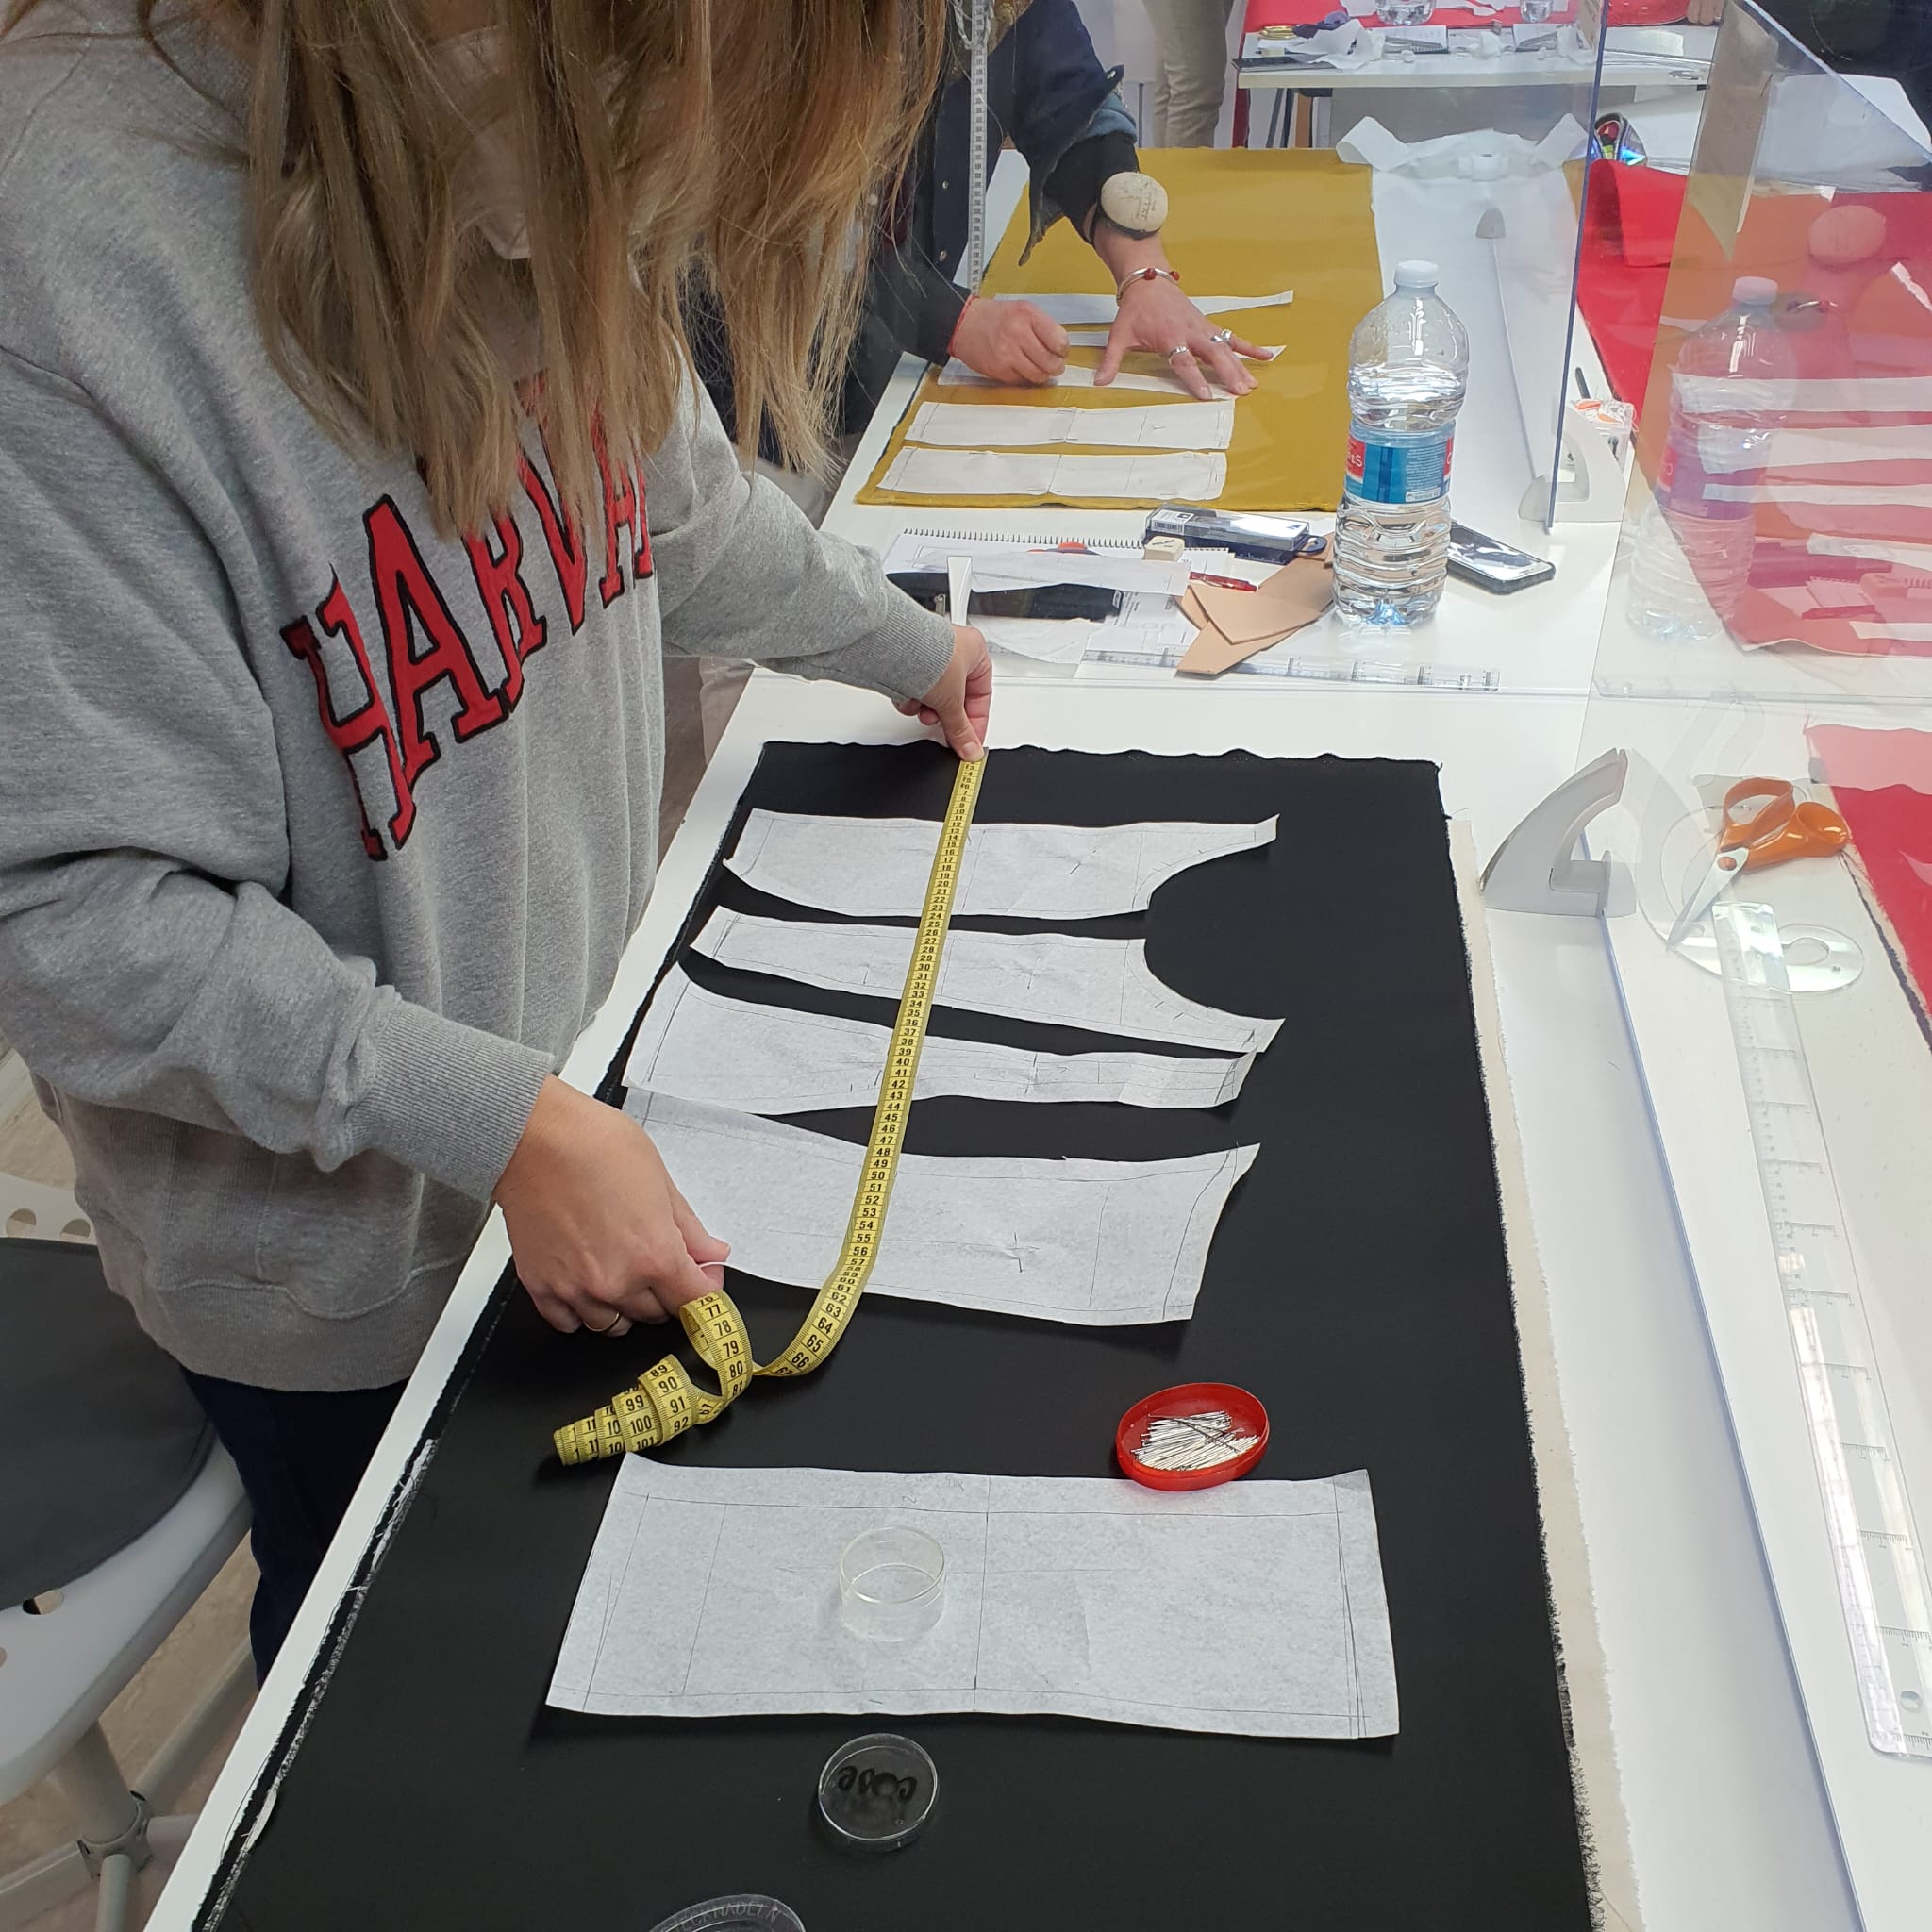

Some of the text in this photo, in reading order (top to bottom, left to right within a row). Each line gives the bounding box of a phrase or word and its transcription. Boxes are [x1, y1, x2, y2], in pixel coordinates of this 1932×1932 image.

[891, 1079, 906, 1089] 42
[890, 1091, 903, 1100] 43
[885, 1113, 898, 1122] 45
[881, 1124, 896, 1133] 46
[879, 1136, 893, 1144] 47
[876, 1147, 891, 1156] 48
[874, 1159, 889, 1168] 49
[871, 1171, 885, 1180] 50
[869, 1183, 882, 1191] 51
[865, 1195, 880, 1205] 52
[862, 1208, 876, 1217] 53
[858, 1221, 874, 1230] 54
[856, 1233, 871, 1243] 55
[853, 1246, 868, 1256] 56
[838, 1284, 851, 1292] 61
[832, 1292, 847, 1304] 62
[705, 1304, 721, 1317] 77
[825, 1303, 841, 1318] 63
[713, 1320, 732, 1337] 78
[818, 1317, 834, 1334] 64
[723, 1340, 739, 1357] 79
[807, 1334, 823, 1353] 65
[792, 1352, 809, 1368] 66
[650, 1365, 668, 1377] 89
[729, 1360, 743, 1377] 80
[658, 1376, 678, 1393] 90
[626, 1395, 644, 1411] 99
[670, 1396, 685, 1413] 91
[630, 1415, 652, 1434] 100
[674, 1416, 688, 1432] 92
[636, 1436, 654, 1449] 101
